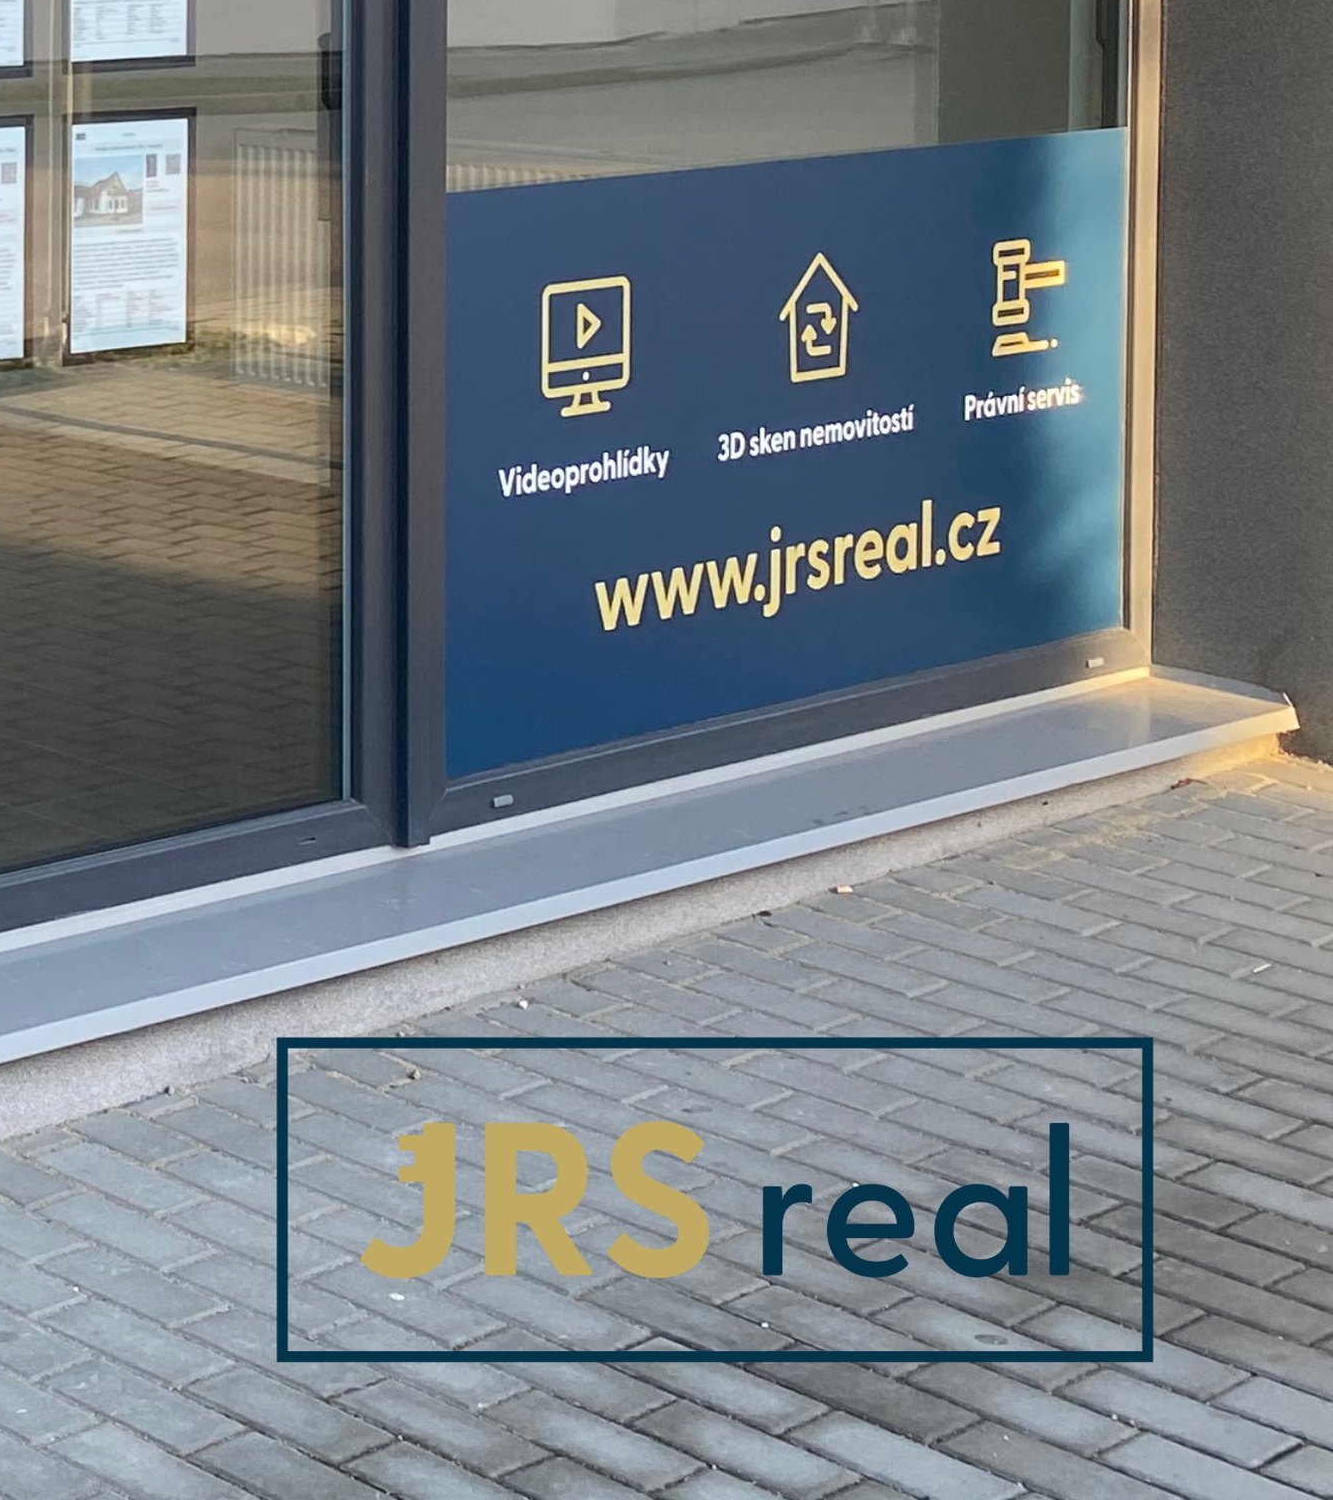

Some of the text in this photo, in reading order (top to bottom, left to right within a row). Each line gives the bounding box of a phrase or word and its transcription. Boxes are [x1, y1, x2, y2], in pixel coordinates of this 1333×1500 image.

[963, 377, 1083, 422] Právní servis
[717, 403, 916, 462] 3D sken nemovitostí
[497, 445, 671, 498] Videoprohlídky
[595, 499, 1002, 632] www.jrsreal.cz
